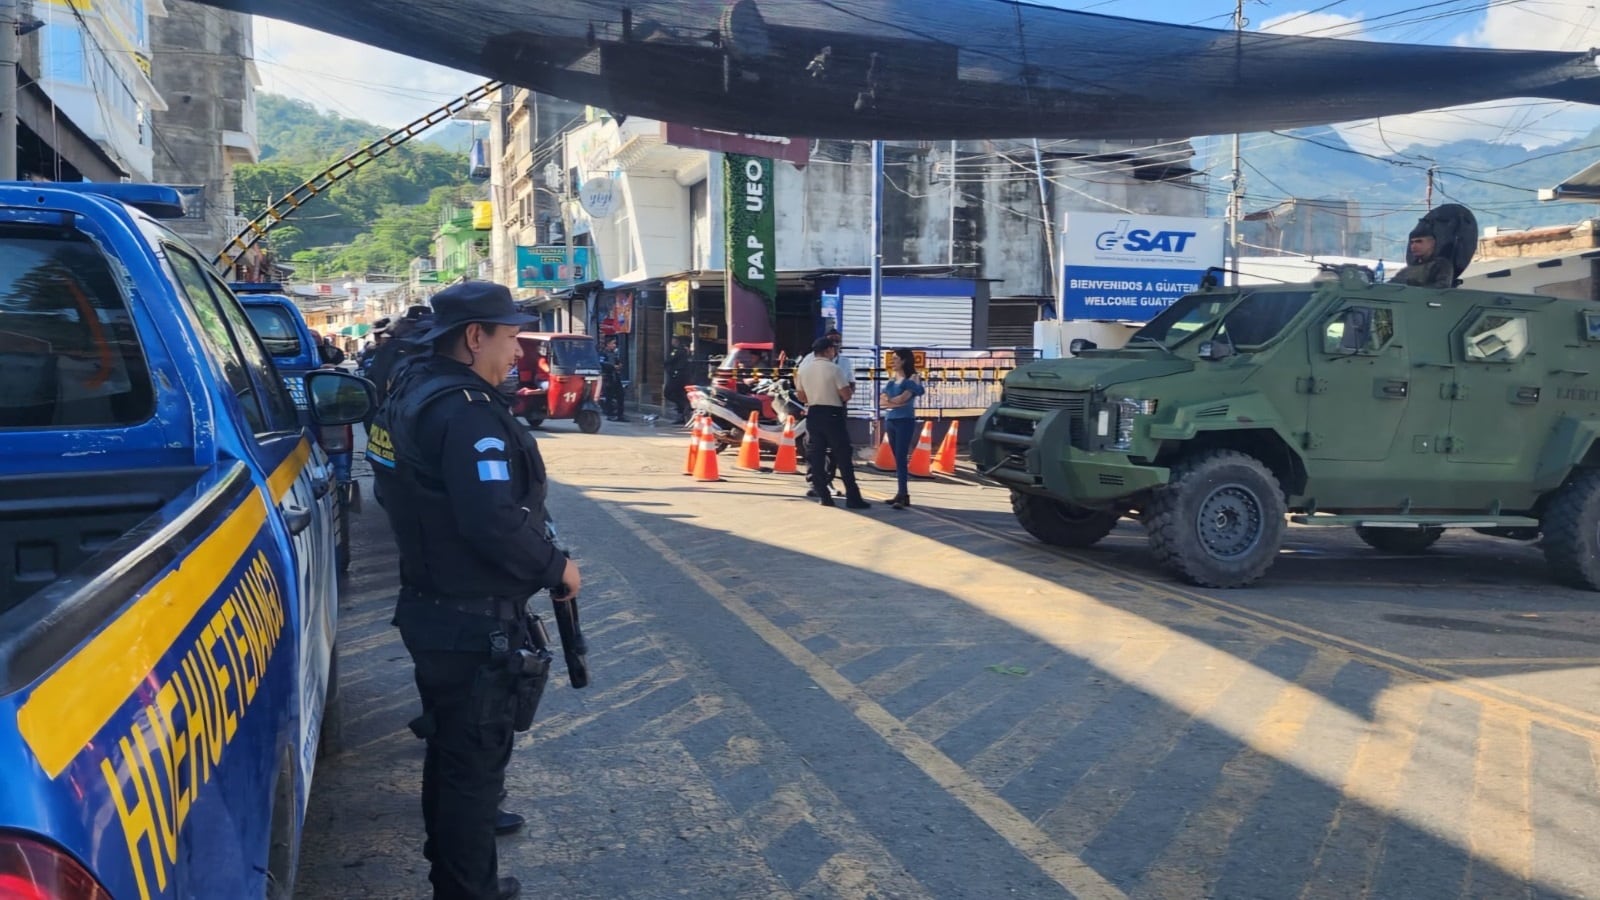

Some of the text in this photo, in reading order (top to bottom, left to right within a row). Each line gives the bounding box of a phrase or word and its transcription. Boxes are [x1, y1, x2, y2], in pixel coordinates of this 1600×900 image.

[1123, 229, 1197, 253] SAT
[1070, 279, 1143, 291] BIENVENIDOS
[1145, 282, 1153, 292] A
[1084, 296, 1137, 306] WELCOME
[563, 391, 577, 403] 11
[100, 549, 285, 900] HUEHUETENANGO
